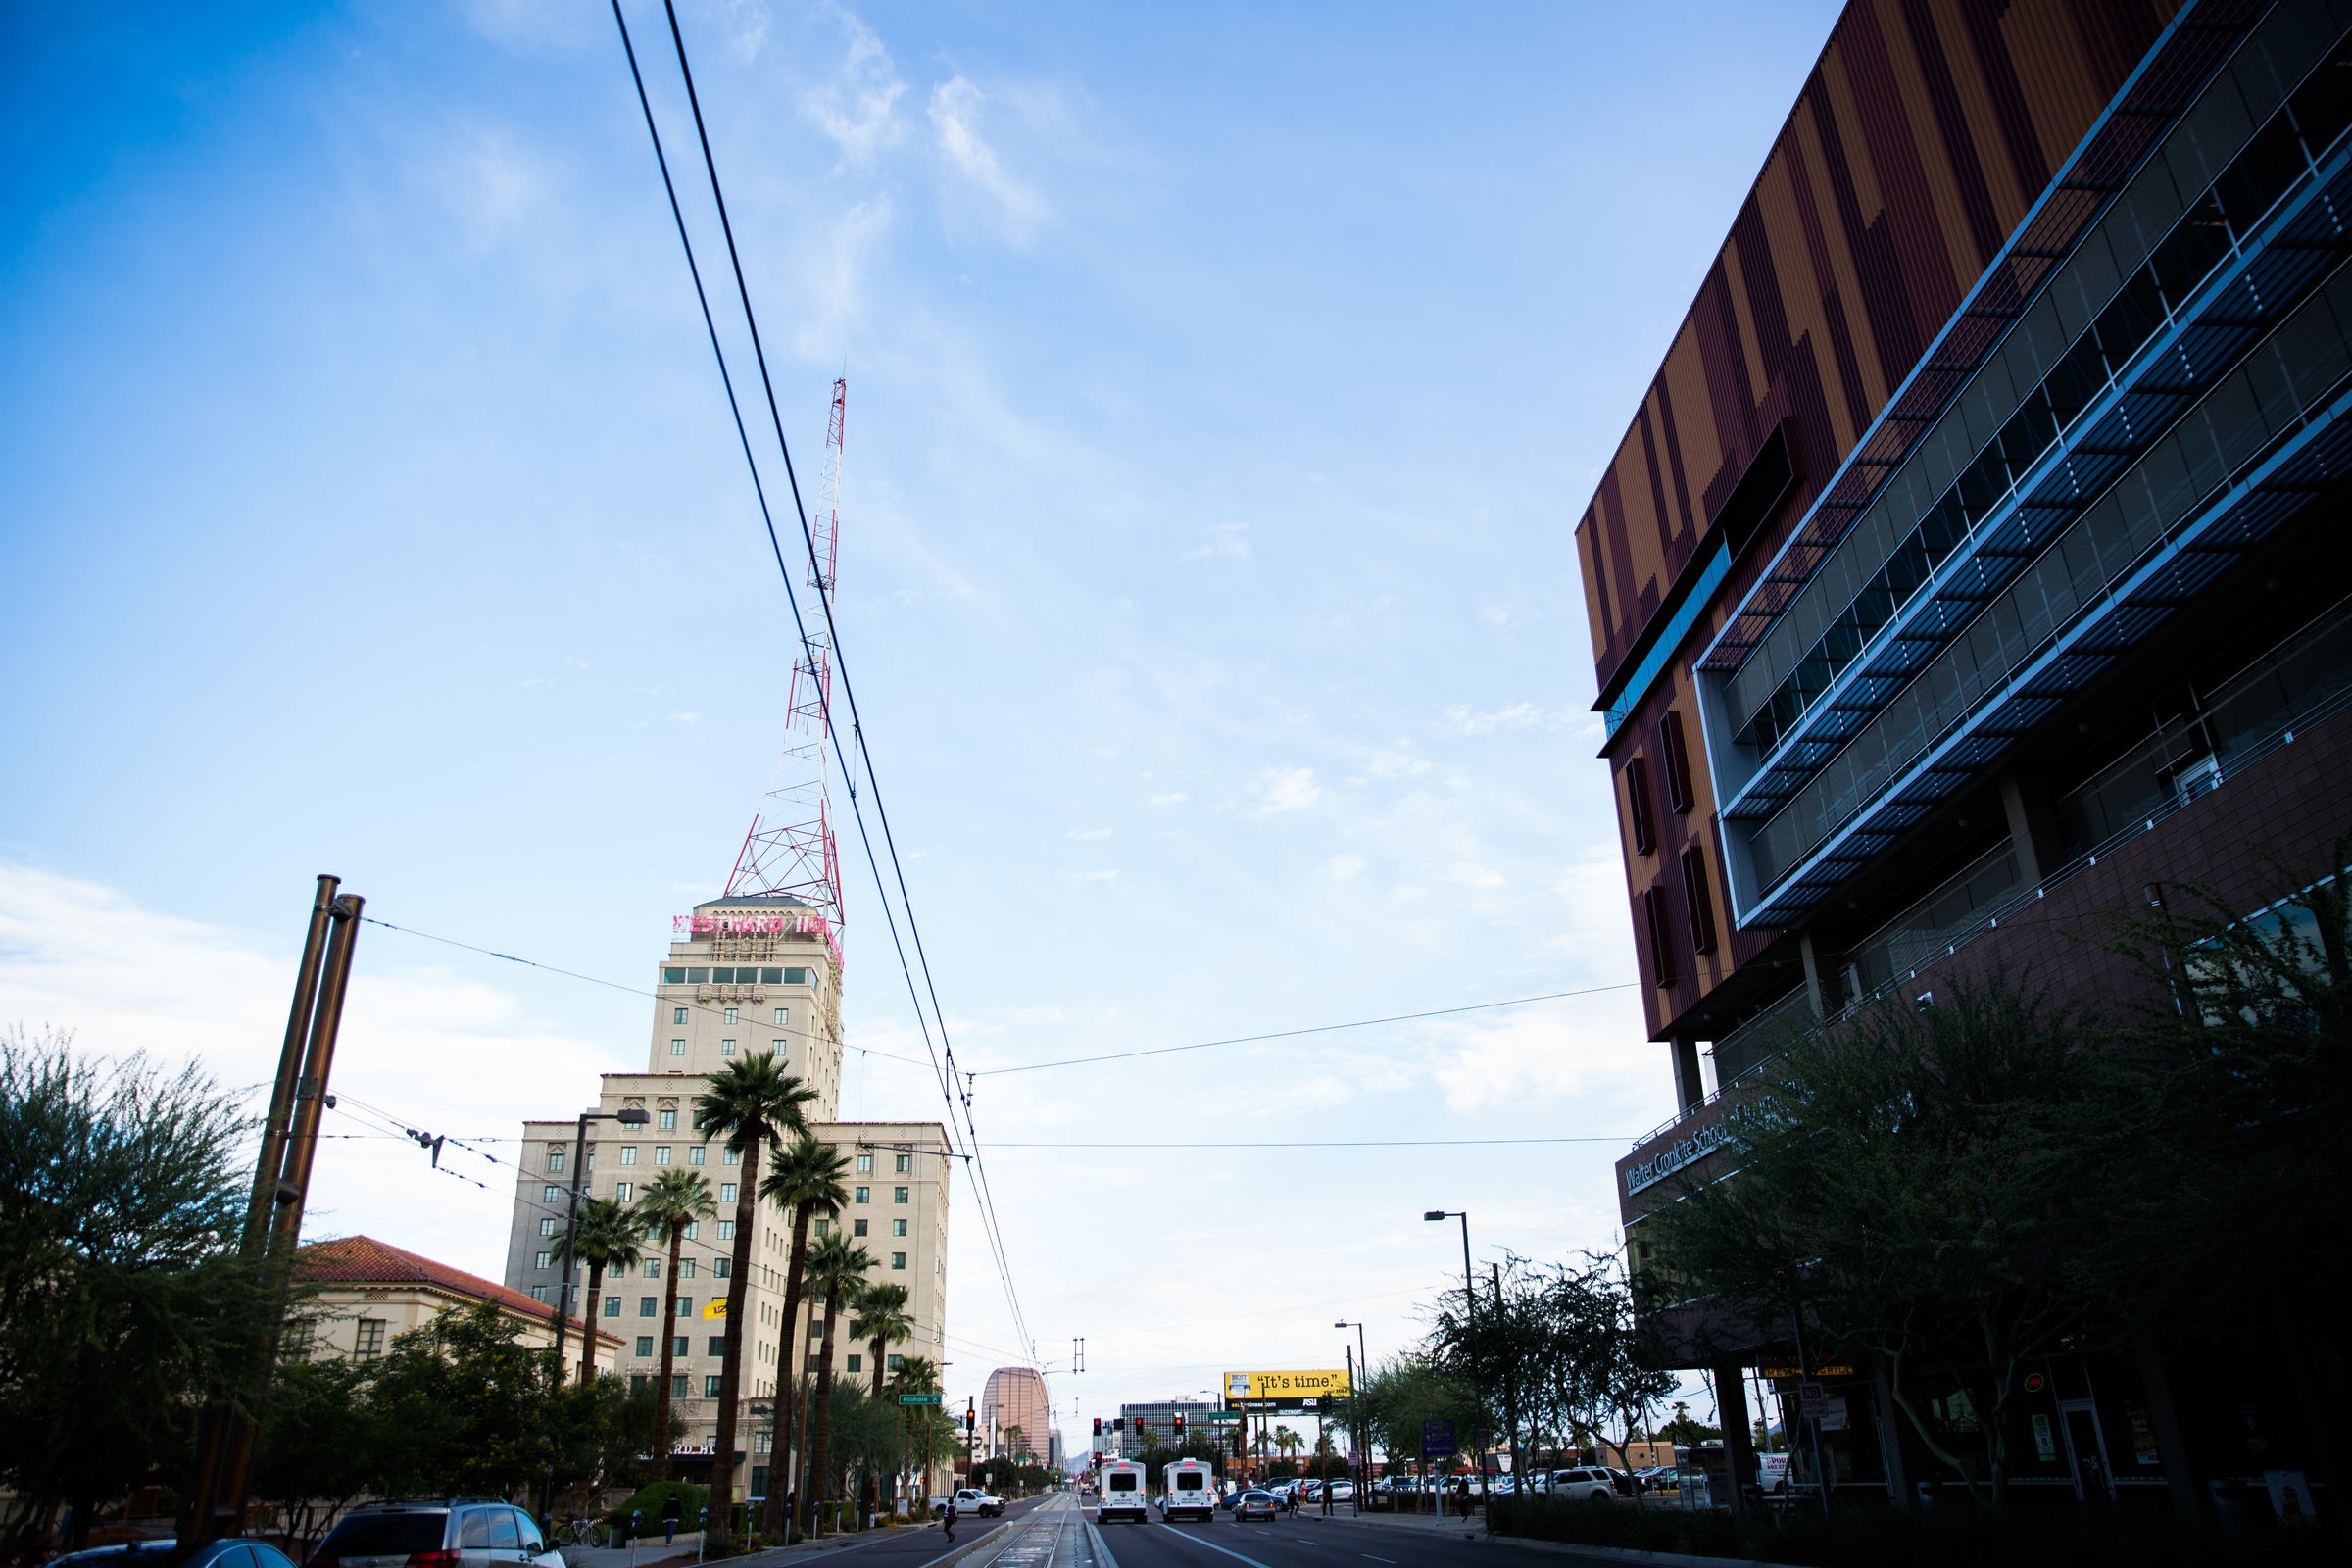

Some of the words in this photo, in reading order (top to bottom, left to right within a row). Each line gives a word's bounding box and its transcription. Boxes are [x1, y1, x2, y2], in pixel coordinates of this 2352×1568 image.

[672, 914, 783, 933] WESTWARD
[1625, 1161, 1653, 1190] Walter
[1654, 1139, 1693, 1174] Cronkite
[1804, 1388, 1820, 1397] NO
